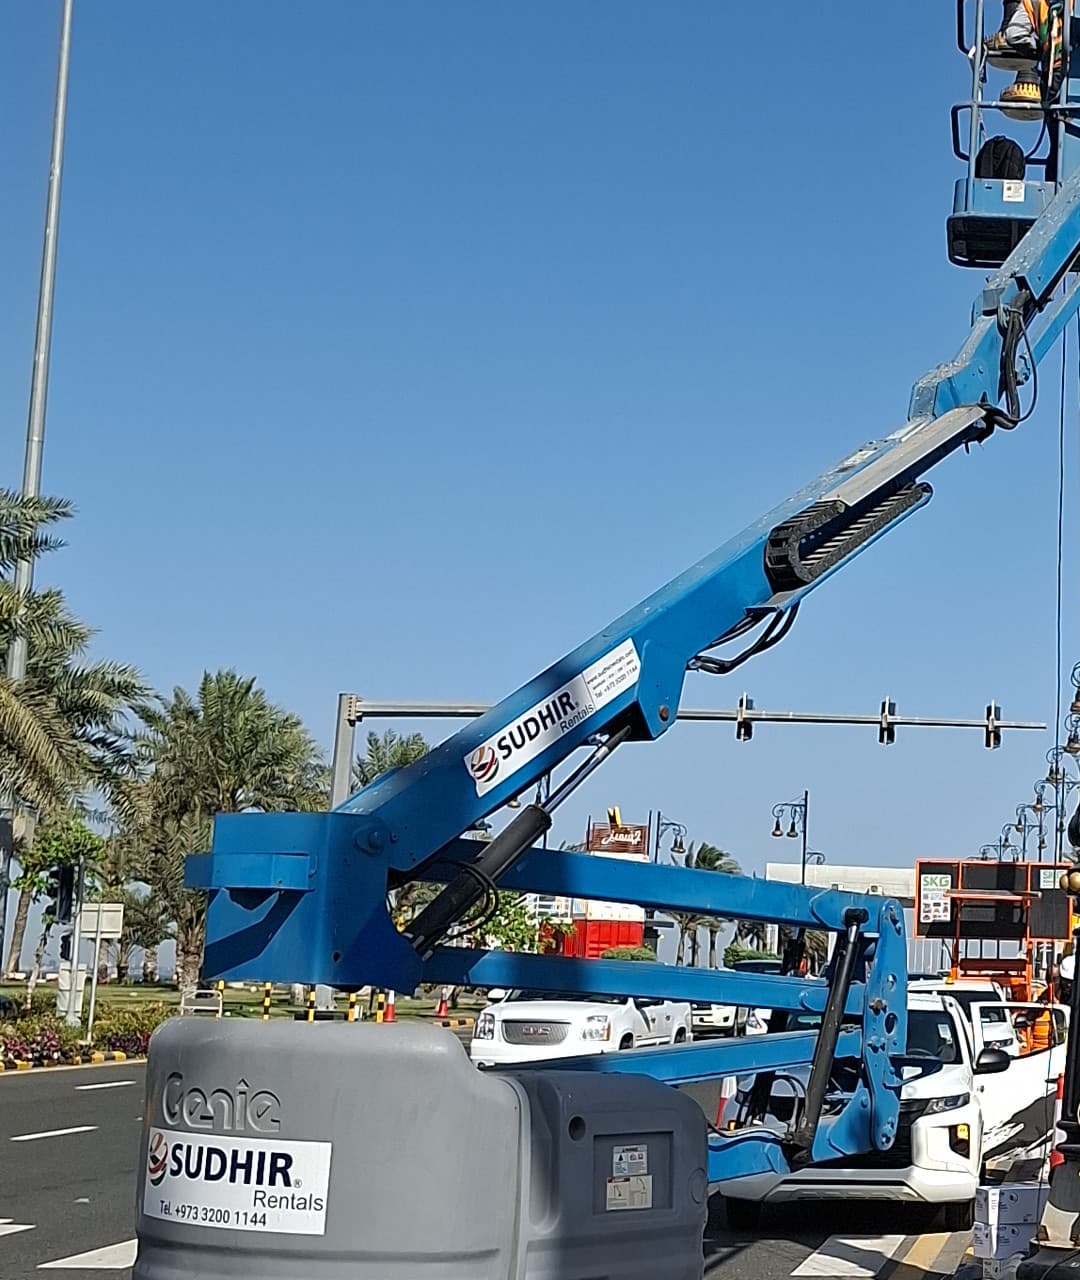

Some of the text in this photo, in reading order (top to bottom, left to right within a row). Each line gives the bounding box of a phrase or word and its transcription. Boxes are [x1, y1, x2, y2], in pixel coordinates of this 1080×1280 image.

[497, 691, 577, 760] SUDHIR
[559, 704, 594, 735] Rentals
[922, 876, 950, 887] SKG
[169, 1142, 294, 1188] SUDHIR
[160, 1200, 267, 1227] Tel. +973 3200 1144
[253, 1190, 324, 1212] Rentals
